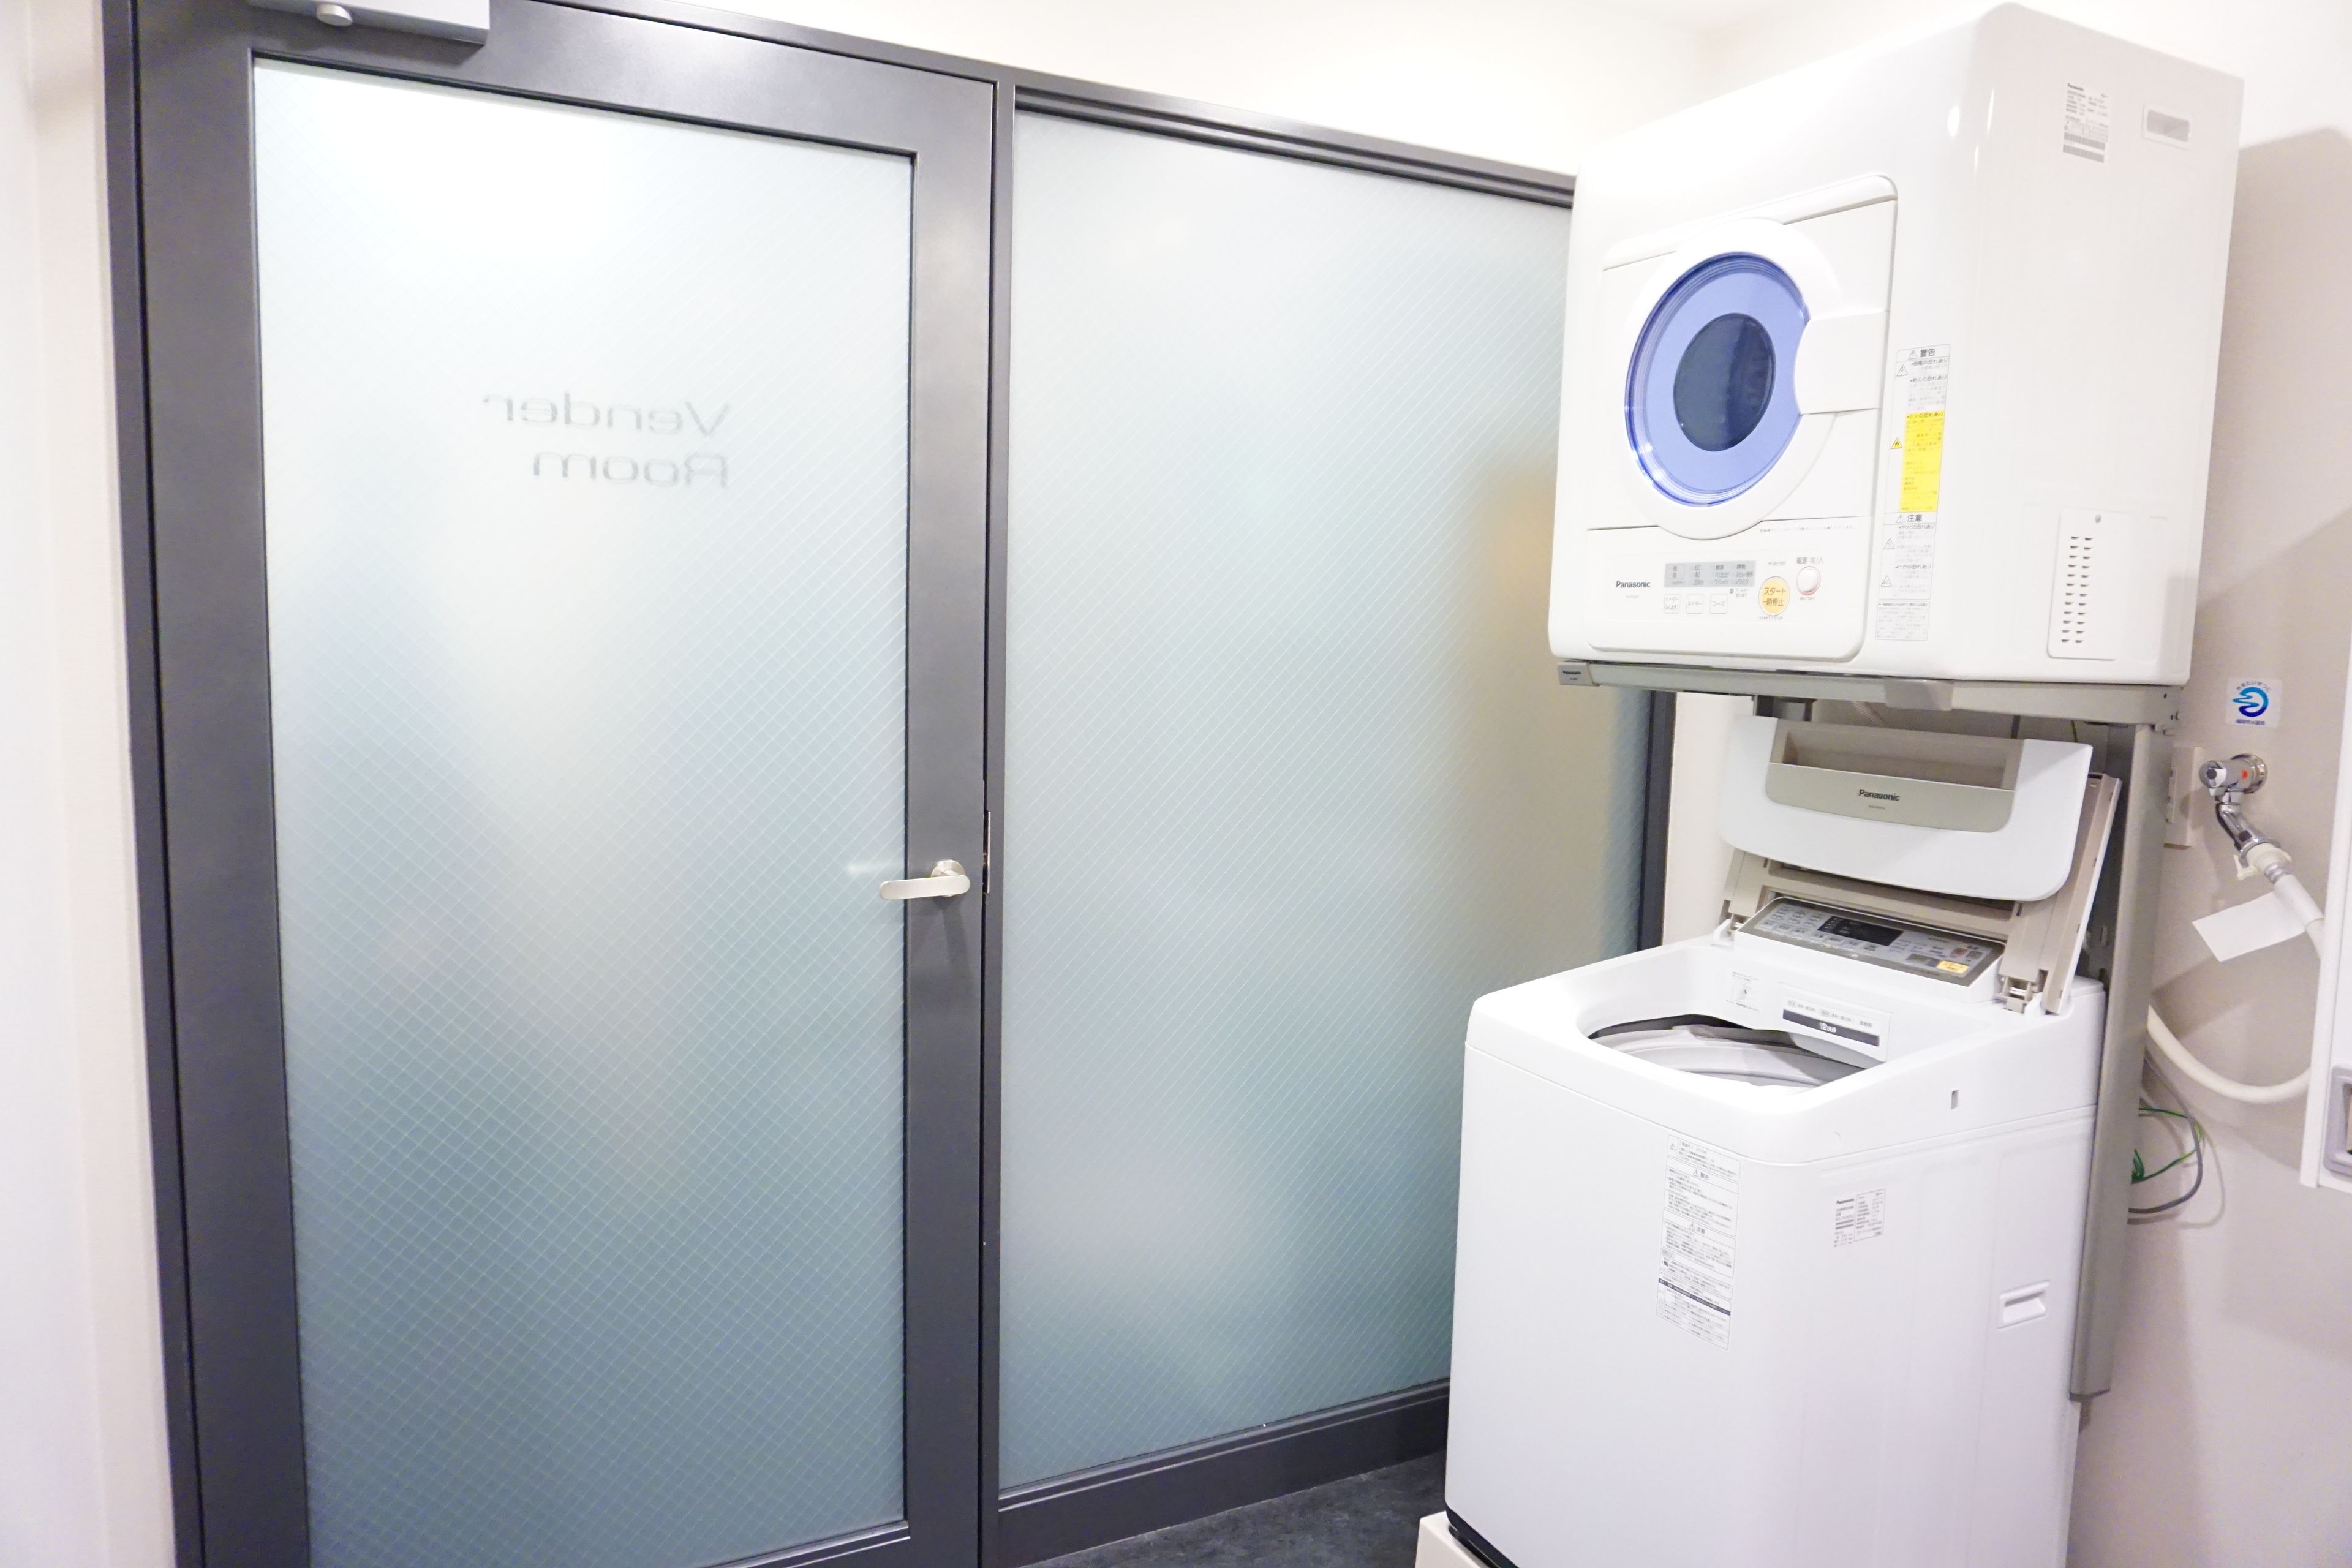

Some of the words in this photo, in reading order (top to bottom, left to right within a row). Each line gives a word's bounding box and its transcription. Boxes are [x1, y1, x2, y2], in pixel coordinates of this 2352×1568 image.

[1920, 348, 1936, 357] 警告
[1907, 514, 1922, 522] 注意
[1764, 587, 1787, 595] スタート
[1762, 598, 1784, 606] 一時停止
[1858, 789, 1901, 801] Panasonic
